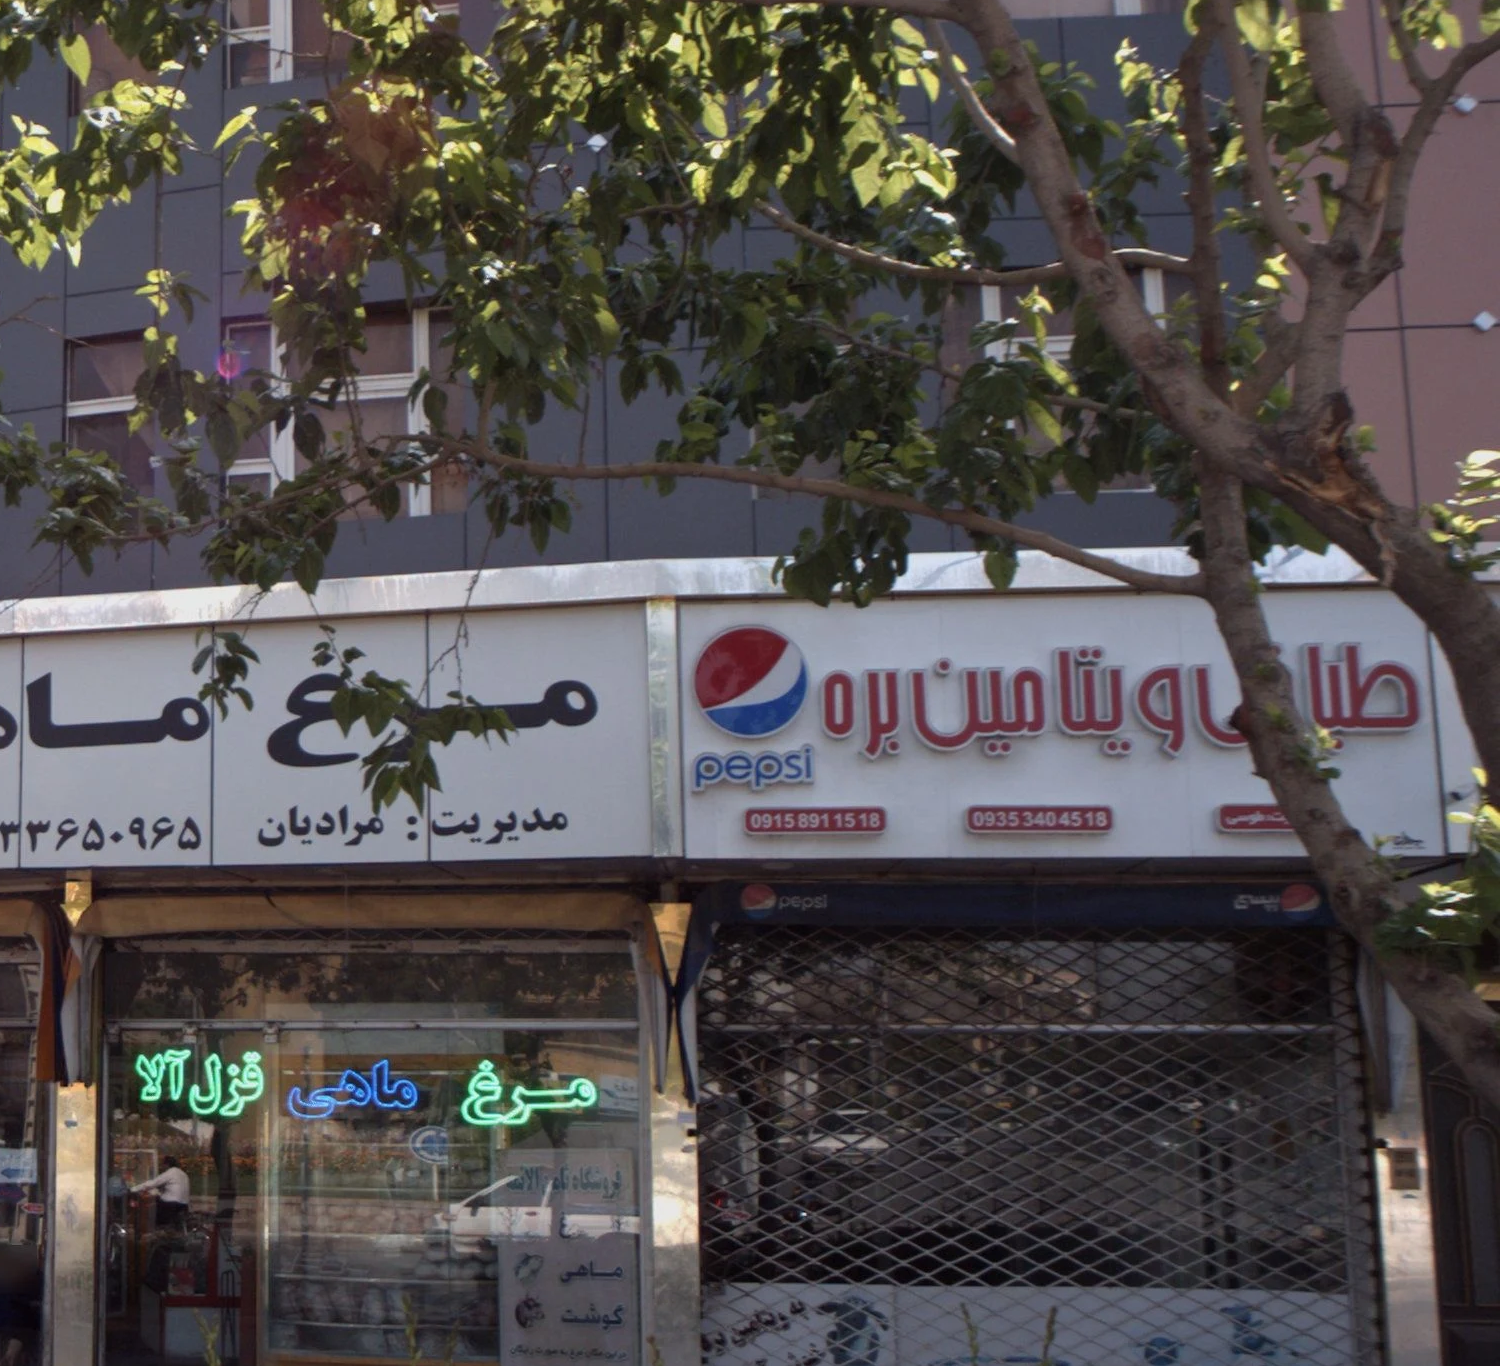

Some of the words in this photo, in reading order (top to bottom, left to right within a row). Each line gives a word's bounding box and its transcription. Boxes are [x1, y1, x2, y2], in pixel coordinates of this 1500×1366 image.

[823, 667, 901, 759] بره
[908, 646, 1185, 756] ویتامین
[694, 747, 812, 788] pepsi
[257, 805, 384, 848] مرادیان
[778, 893, 828, 911] pepsi
[134, 1048, 190, 1103] آلا
[188, 1050, 266, 1117] قزل
[286, 1058, 419, 1119] ماهی
[459, 1058, 599, 1126] مرغ
[560, 1260, 623, 1283] ماهی
[561, 1302, 624, 1330] گوشت
